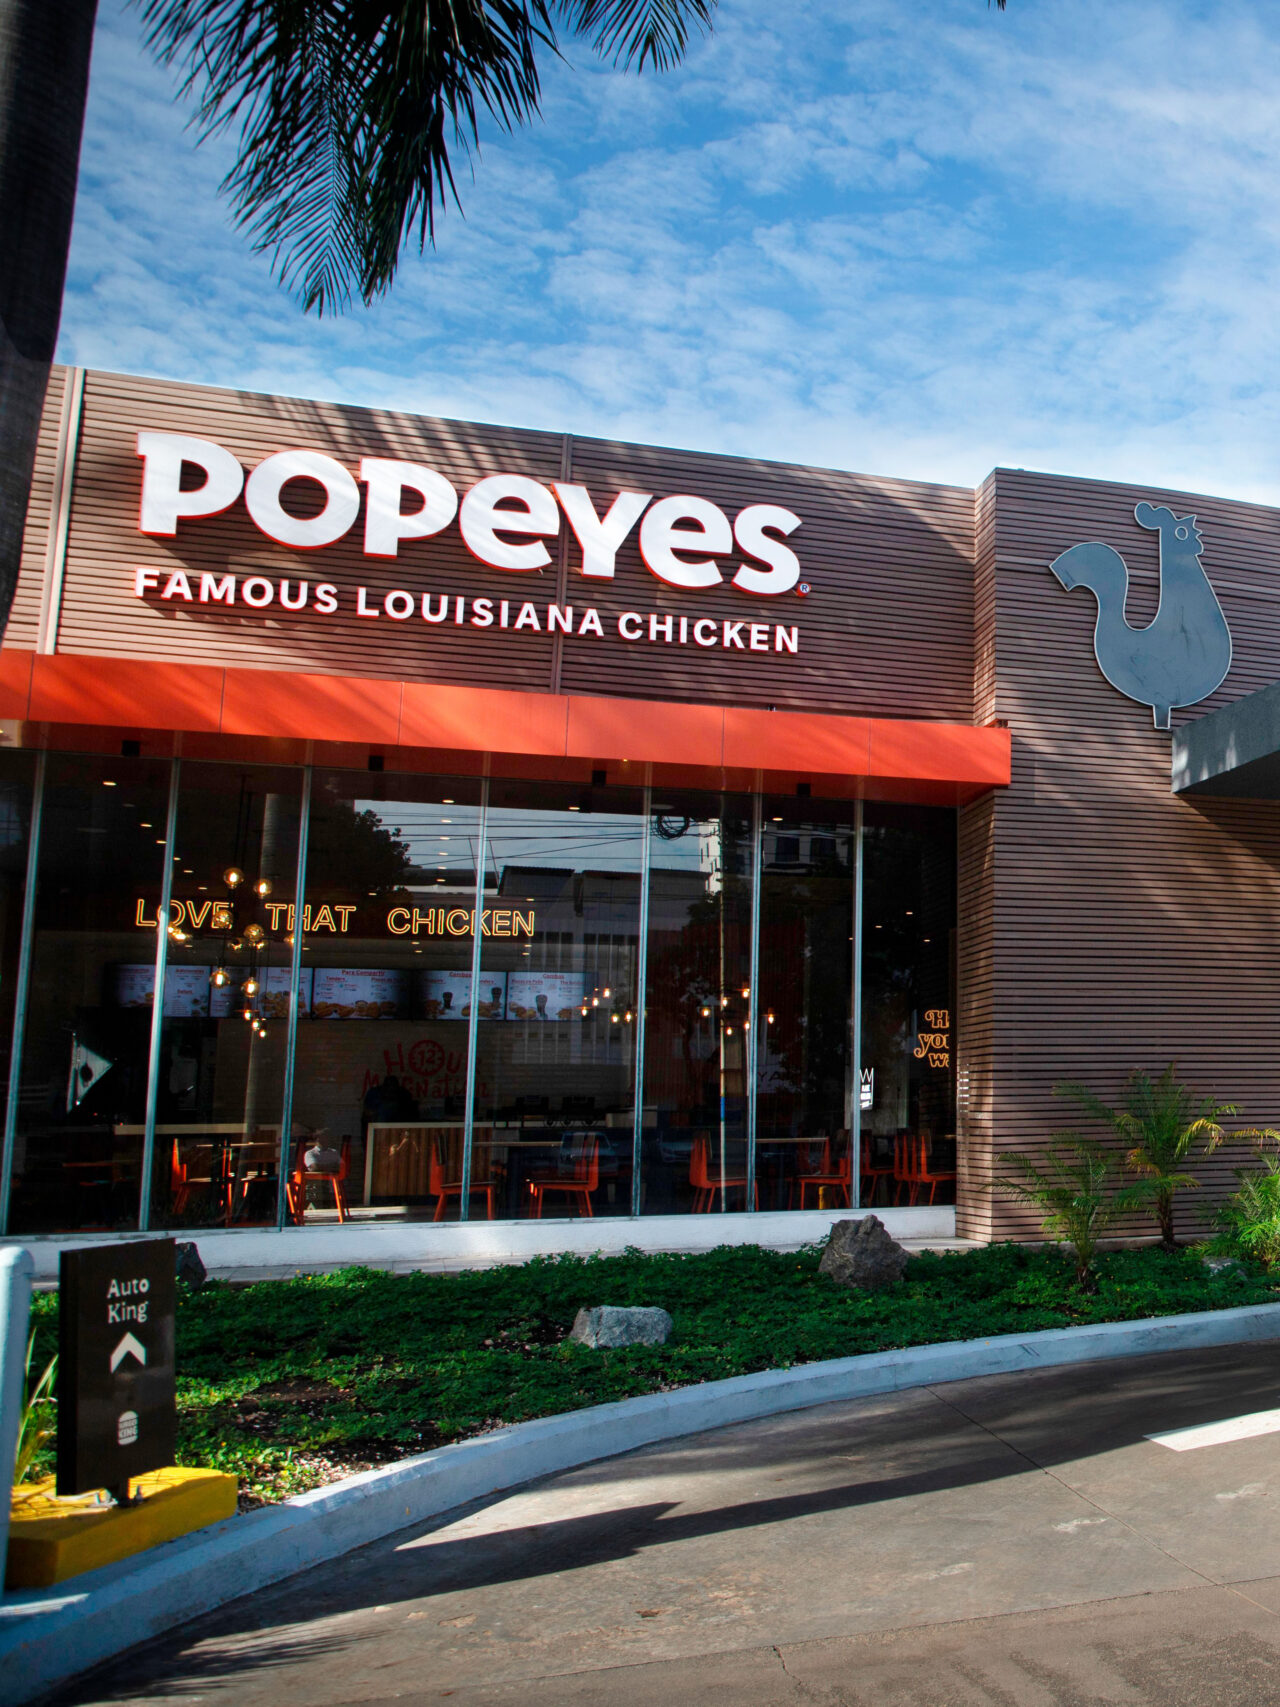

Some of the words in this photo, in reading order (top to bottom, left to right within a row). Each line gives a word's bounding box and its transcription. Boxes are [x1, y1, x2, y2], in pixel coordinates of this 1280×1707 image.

[135, 567, 338, 614] FAMOUS
[356, 586, 604, 637] LOUISIANA
[617, 611, 799, 654] CHICKEN
[136, 898, 233, 929] LOVE
[264, 903, 357, 932] THAT
[387, 907, 535, 937] CHICKEN
[107, 1278, 150, 1298] Auto
[107, 1301, 149, 1324] King
